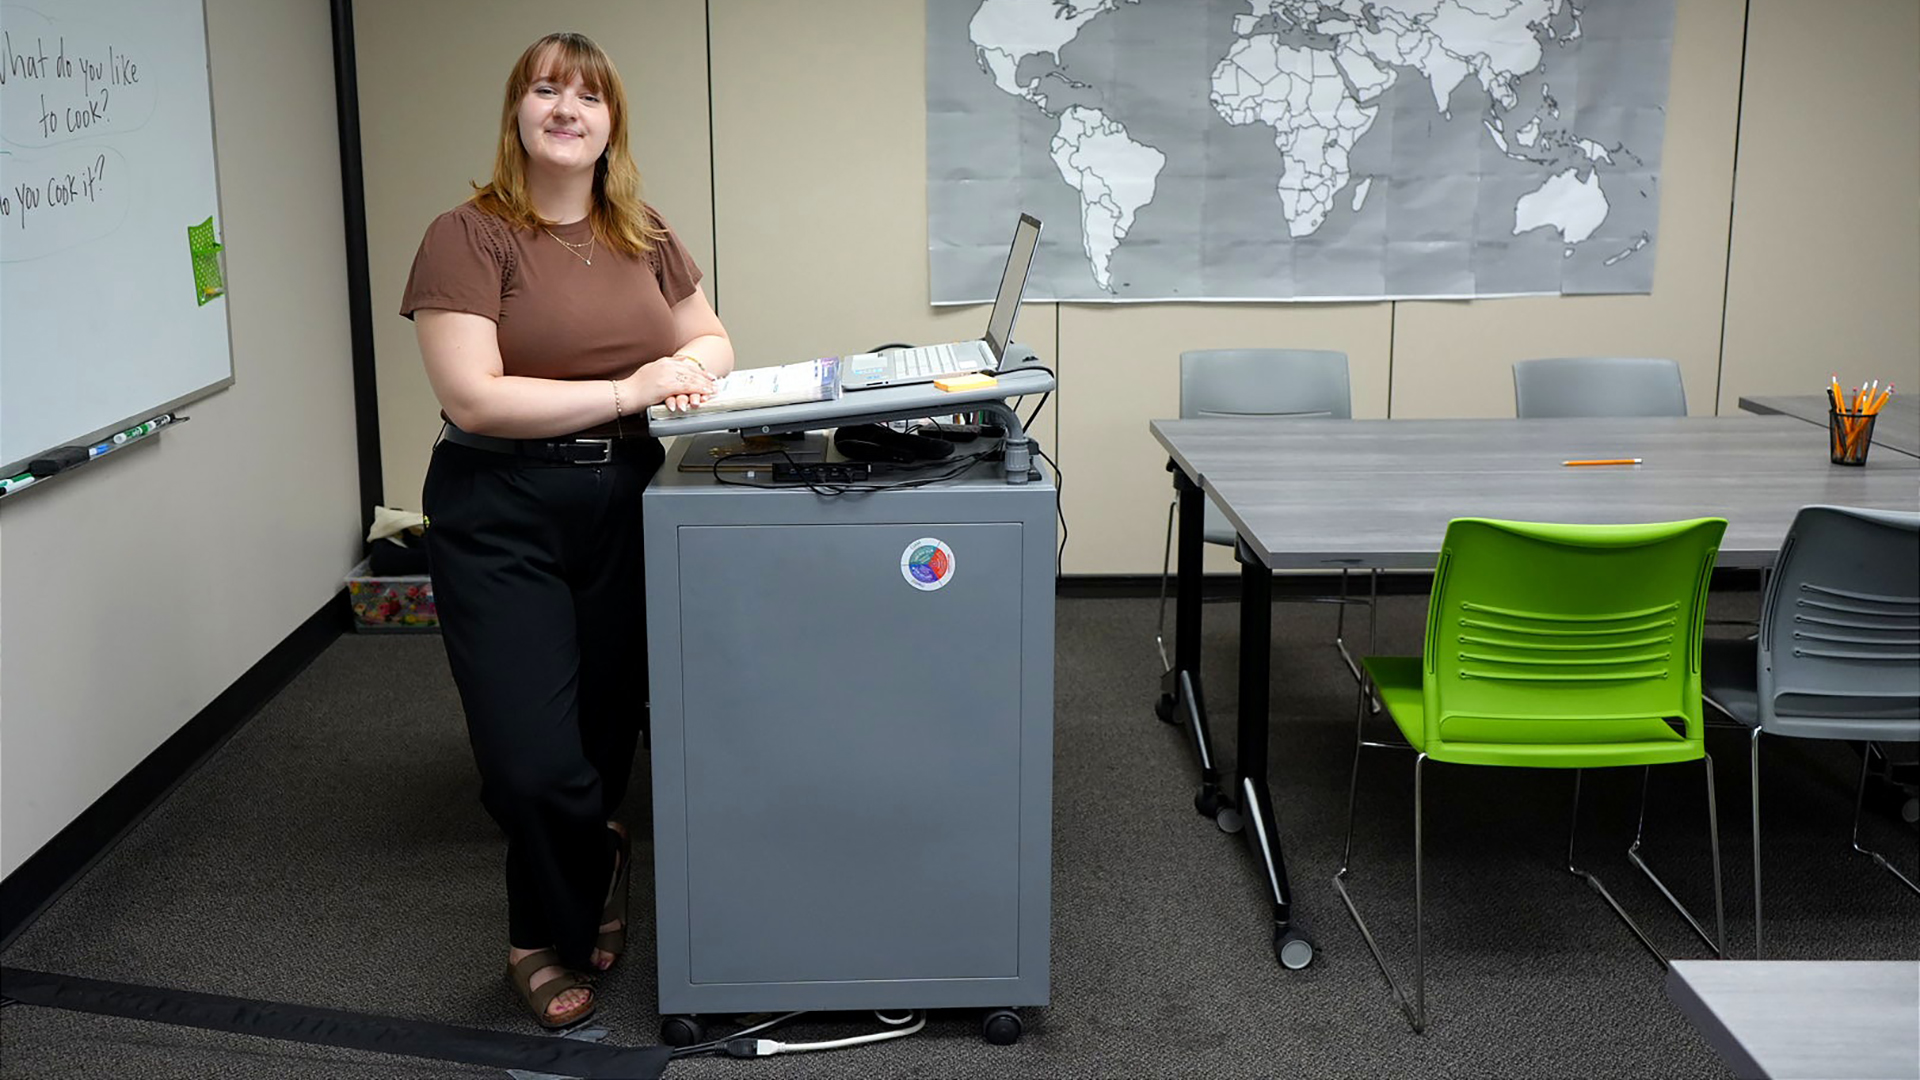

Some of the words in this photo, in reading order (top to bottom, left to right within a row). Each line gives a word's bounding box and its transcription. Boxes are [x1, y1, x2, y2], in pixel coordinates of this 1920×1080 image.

[57, 36, 72, 78] do
[79, 58, 103, 96] you
[109, 46, 139, 85] like
[39, 94, 57, 138] to
[66, 88, 110, 133] cook?
[15, 183, 39, 229] you
[82, 154, 105, 202] it?
